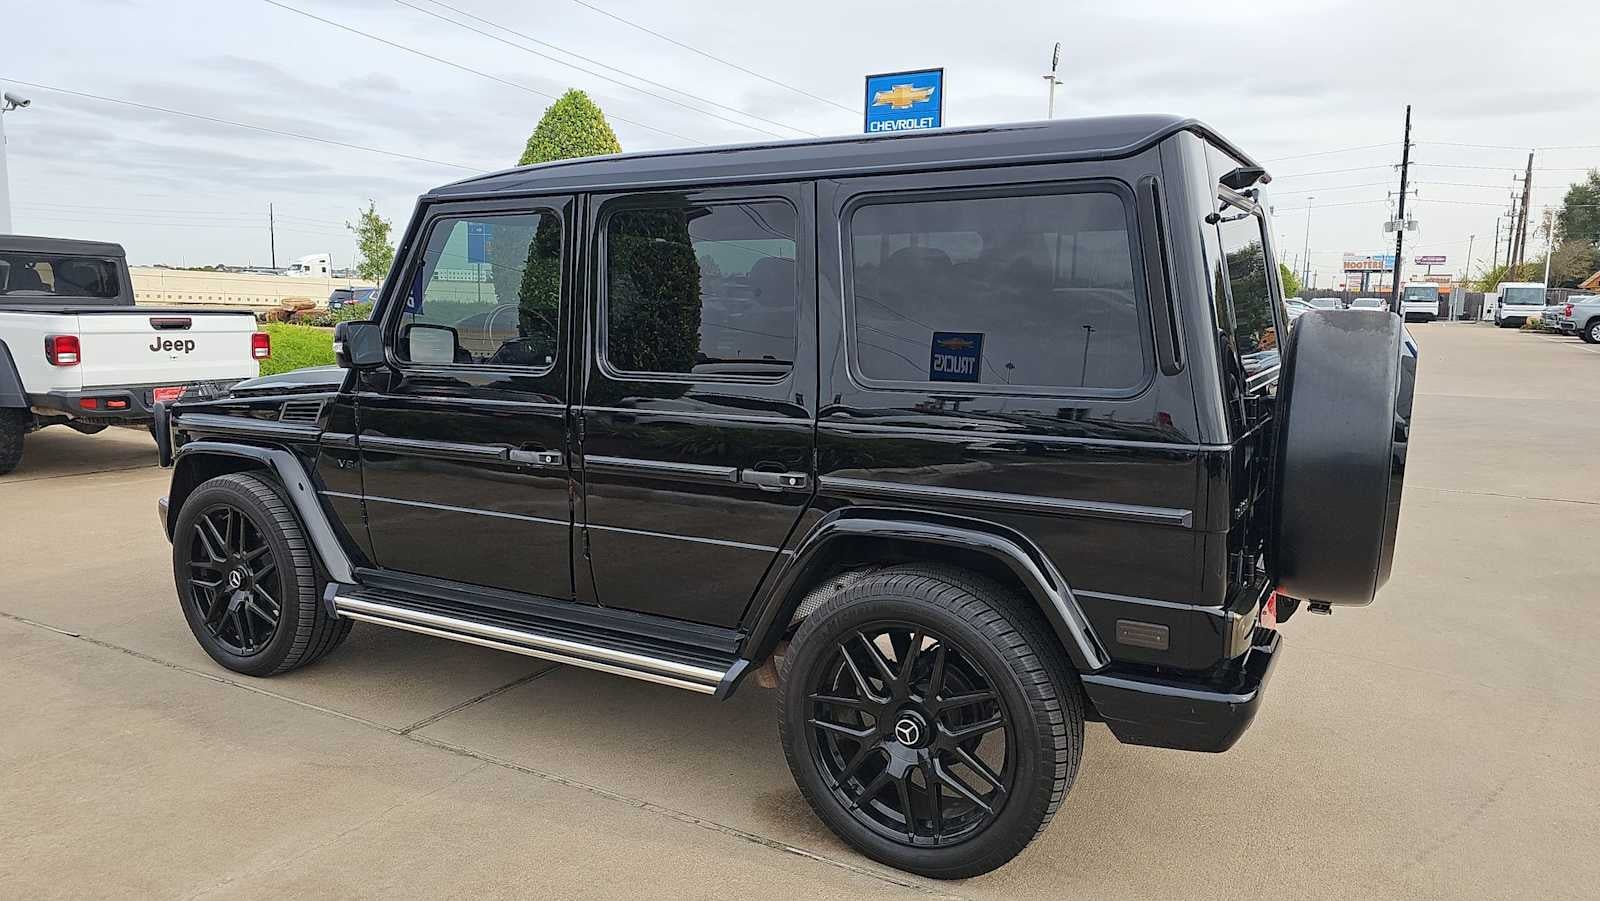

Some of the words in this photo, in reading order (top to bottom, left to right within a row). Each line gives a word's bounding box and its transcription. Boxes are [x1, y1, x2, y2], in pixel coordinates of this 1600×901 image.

[870, 117, 934, 132] CHEVROLET
[1343, 261, 1383, 269] HOOTERS
[149, 336, 195, 354] Jeep
